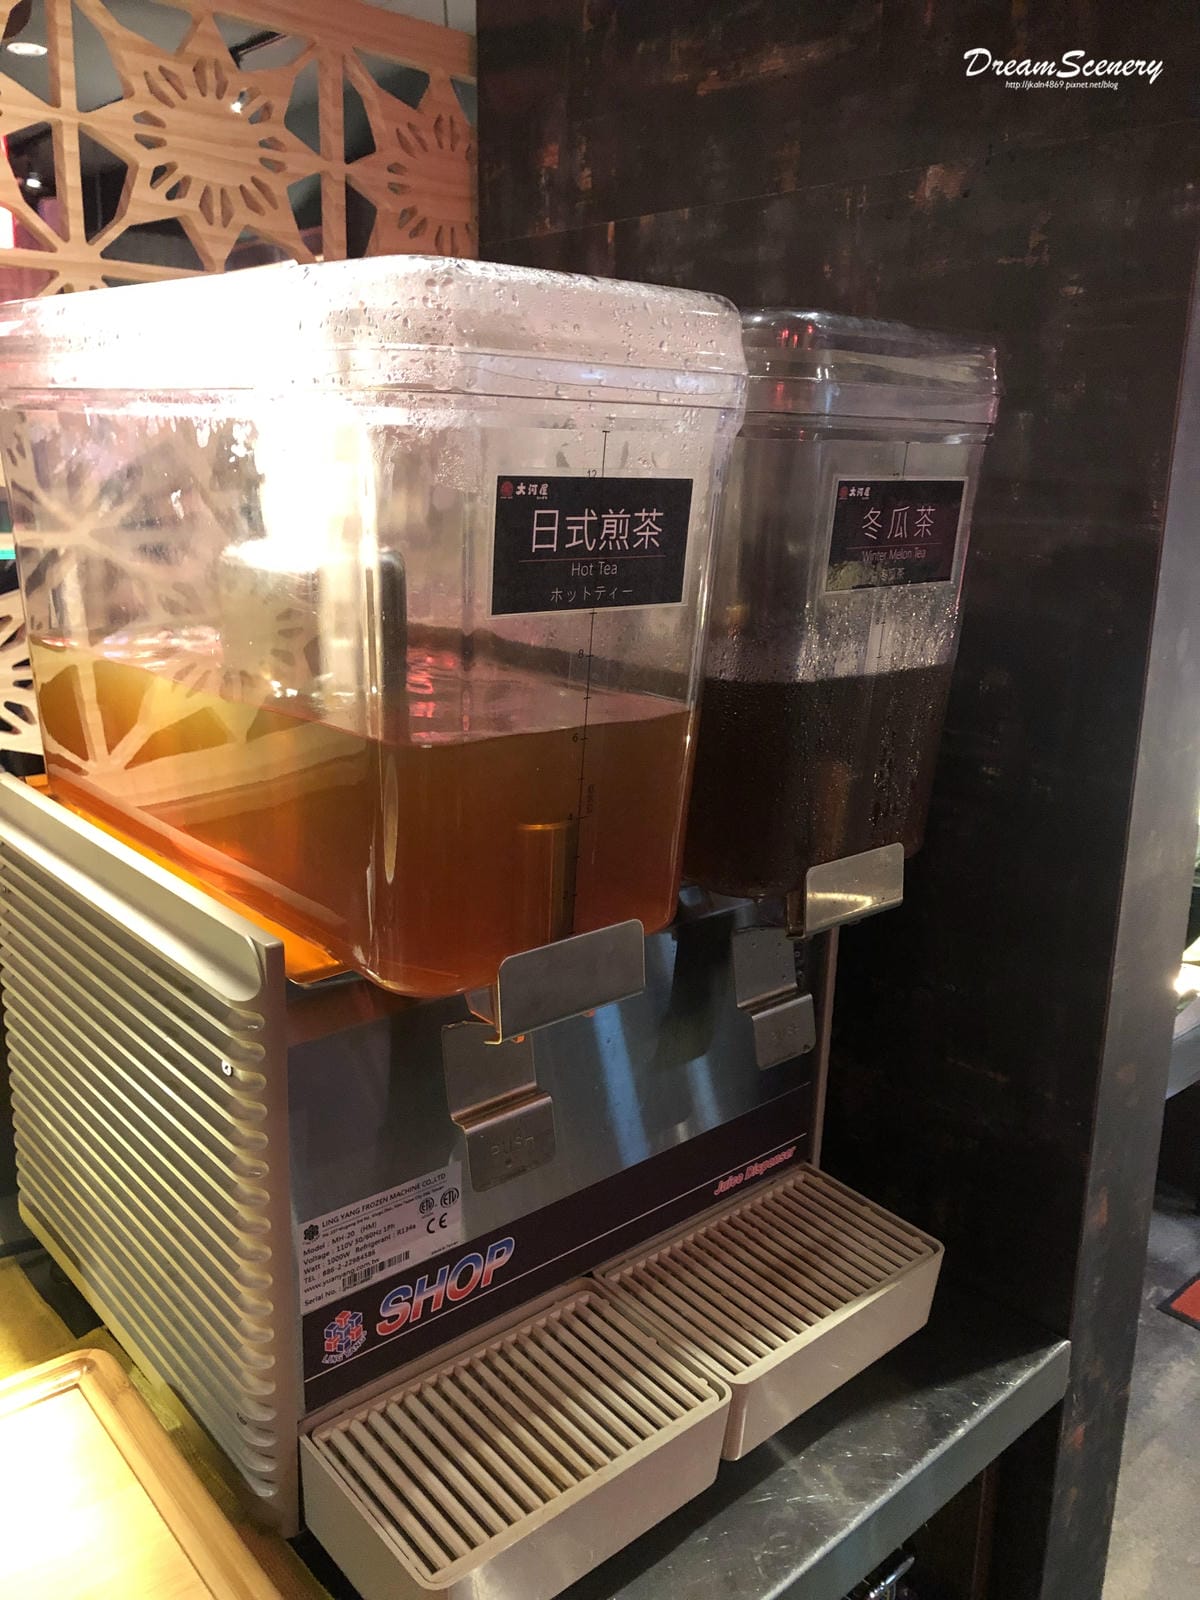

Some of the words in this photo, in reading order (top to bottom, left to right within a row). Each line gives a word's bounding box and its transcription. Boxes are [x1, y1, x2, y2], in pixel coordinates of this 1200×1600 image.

[516, 482, 549, 496] 大河屋
[531, 507, 664, 553] 日式煎茶
[862, 505, 936, 540] 冬瓜茶
[862, 549, 888, 563] Winter
[889, 547, 913, 561] Melon
[914, 546, 927, 559] Tea
[571, 561, 594, 577] Hot
[597, 561, 618, 576] Tea
[550, 585, 633, 603] ホットティー
[322, 1216, 339, 1227] LING
[341, 1207, 360, 1220] YANG
[362, 1196, 389, 1212] FROZEN
[390, 1183, 420, 1200] MACHINE
[376, 1236, 515, 1336] SHOP
